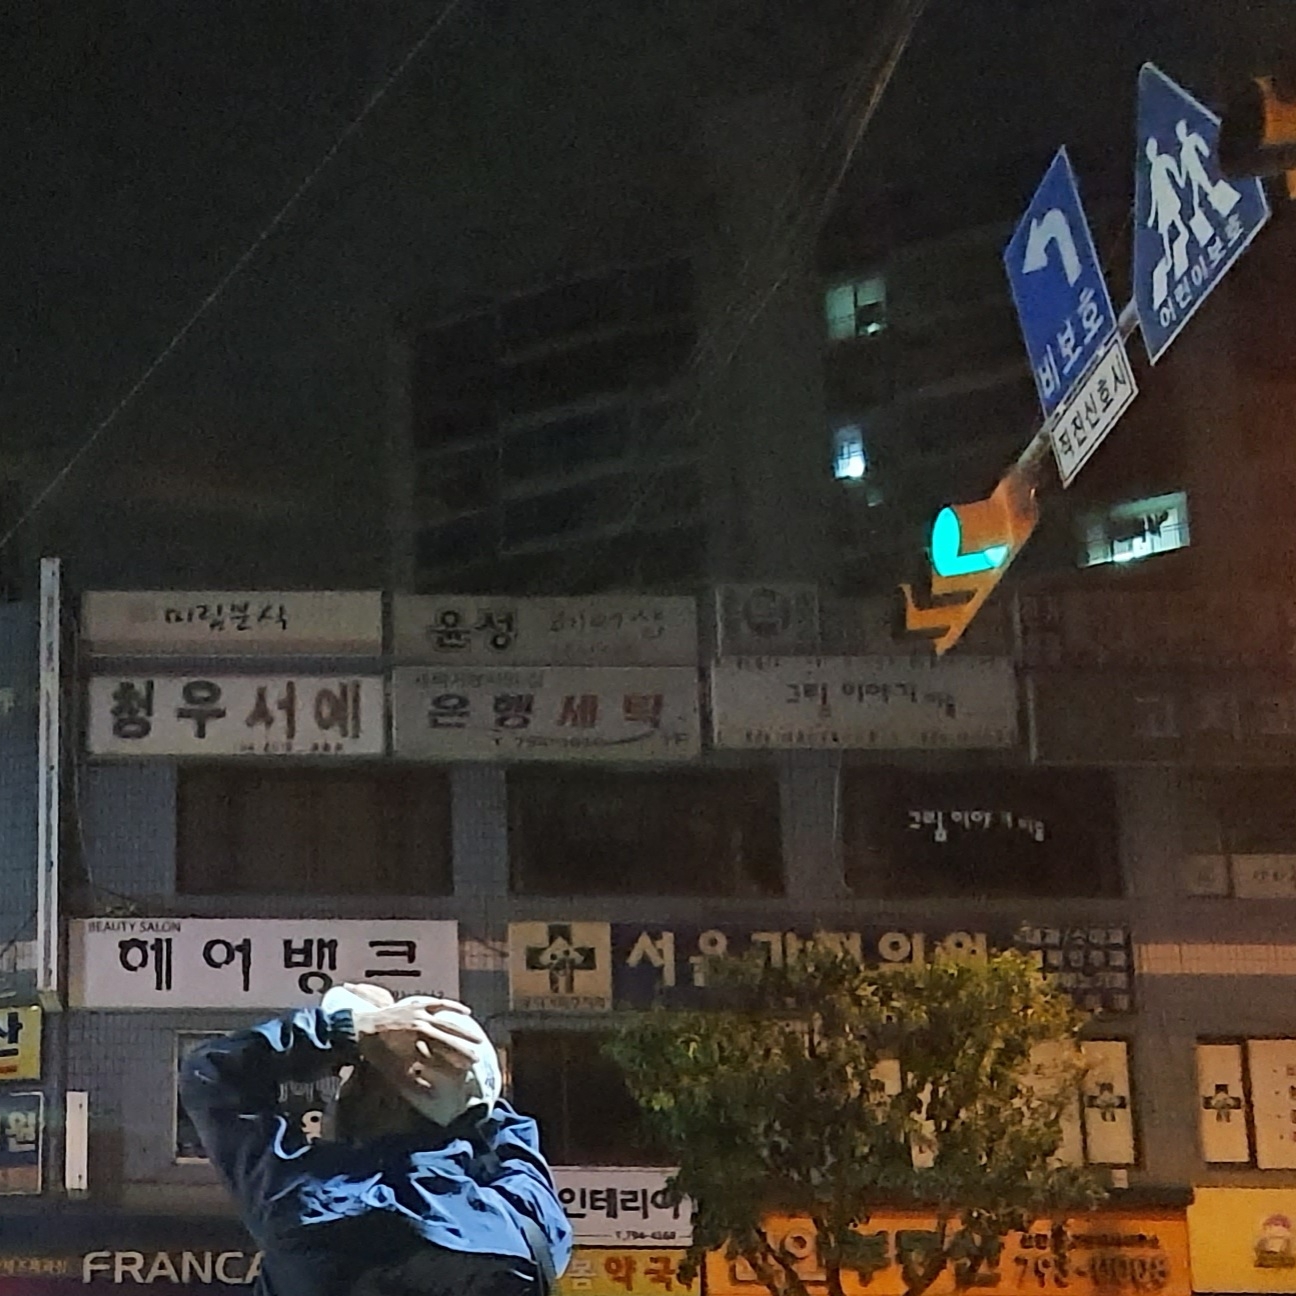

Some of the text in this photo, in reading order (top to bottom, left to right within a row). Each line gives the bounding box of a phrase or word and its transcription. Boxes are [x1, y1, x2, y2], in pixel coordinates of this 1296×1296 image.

[1159, 213, 1246, 328] 어린이보호
[1036, 287, 1105, 400] 비보호
[88, 921, 182, 933] BEAUTY SALON
[117, 937, 422, 995] 헤어뱅크
